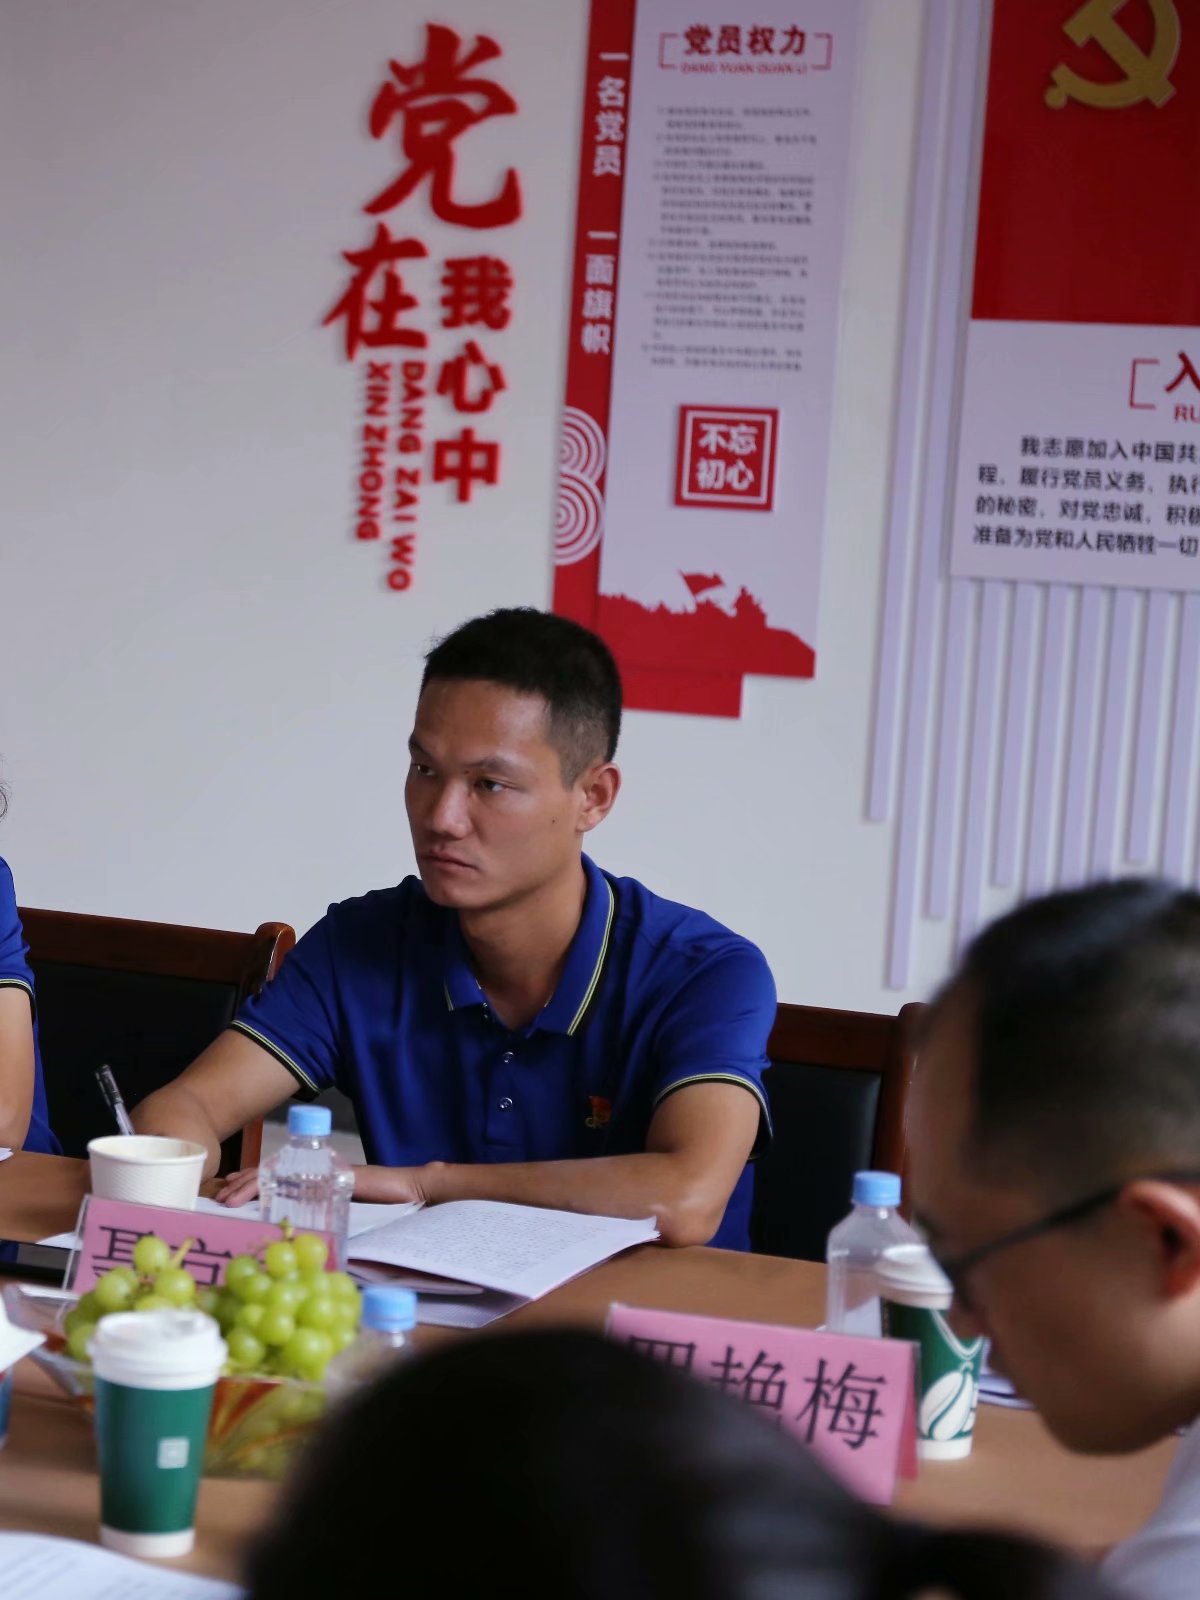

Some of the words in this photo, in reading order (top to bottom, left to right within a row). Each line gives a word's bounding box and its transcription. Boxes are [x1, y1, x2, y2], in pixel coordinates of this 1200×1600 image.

[683, 23, 807, 56] 党员权力
[364, 21, 523, 230] 党
[593, 53, 628, 177] 一名党员
[321, 224, 430, 361] 在
[581, 231, 618, 354] 一面旗帜
[365, 361, 392, 417] XIN
[397, 361, 426, 454] DANG
[432, 255, 513, 503] 我心中
[697, 459, 755, 491] 初心
[698, 422, 758, 456] 不忘
[1021, 435, 1197, 463] 我志愿加入中国共
[356, 424, 388, 540] ZHONG
[393, 468, 420, 522] ZAI
[387, 534, 415, 591] WO
